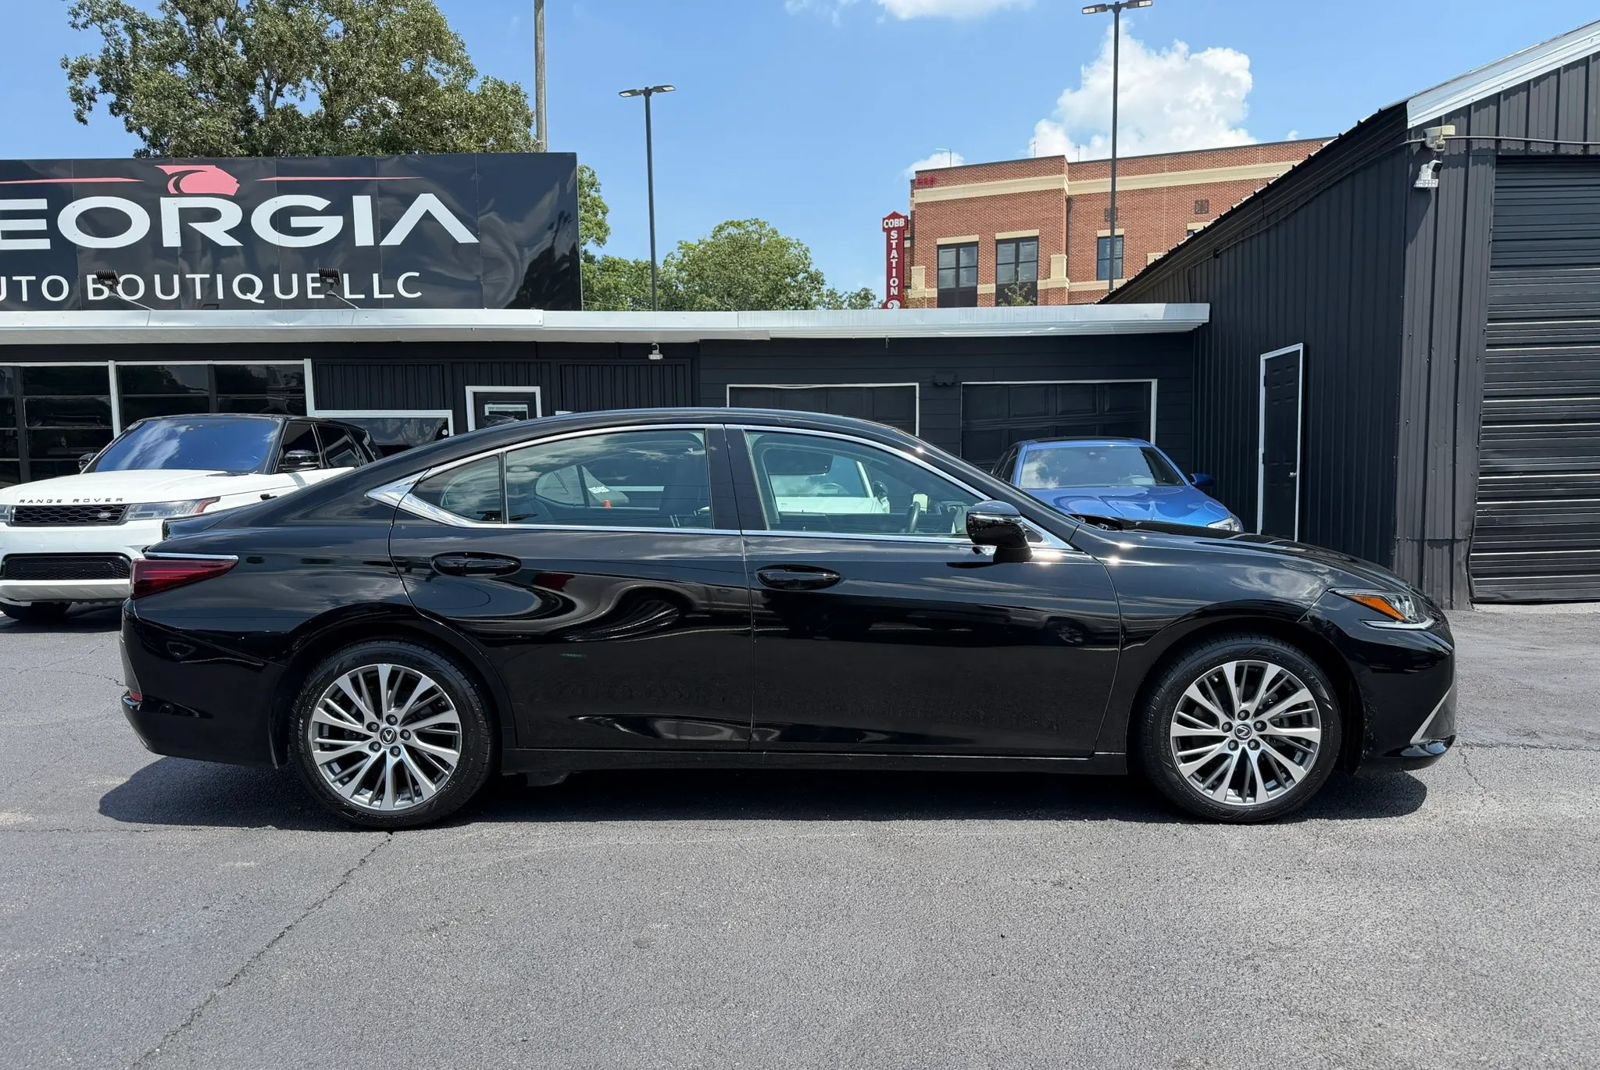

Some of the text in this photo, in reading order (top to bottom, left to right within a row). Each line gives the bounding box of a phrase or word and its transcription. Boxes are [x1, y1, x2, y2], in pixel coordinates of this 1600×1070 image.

[883, 217, 905, 229] COBB
[889, 230, 899, 296] STATION
[0, 272, 422, 304] TO BOUTIQUE LLC
